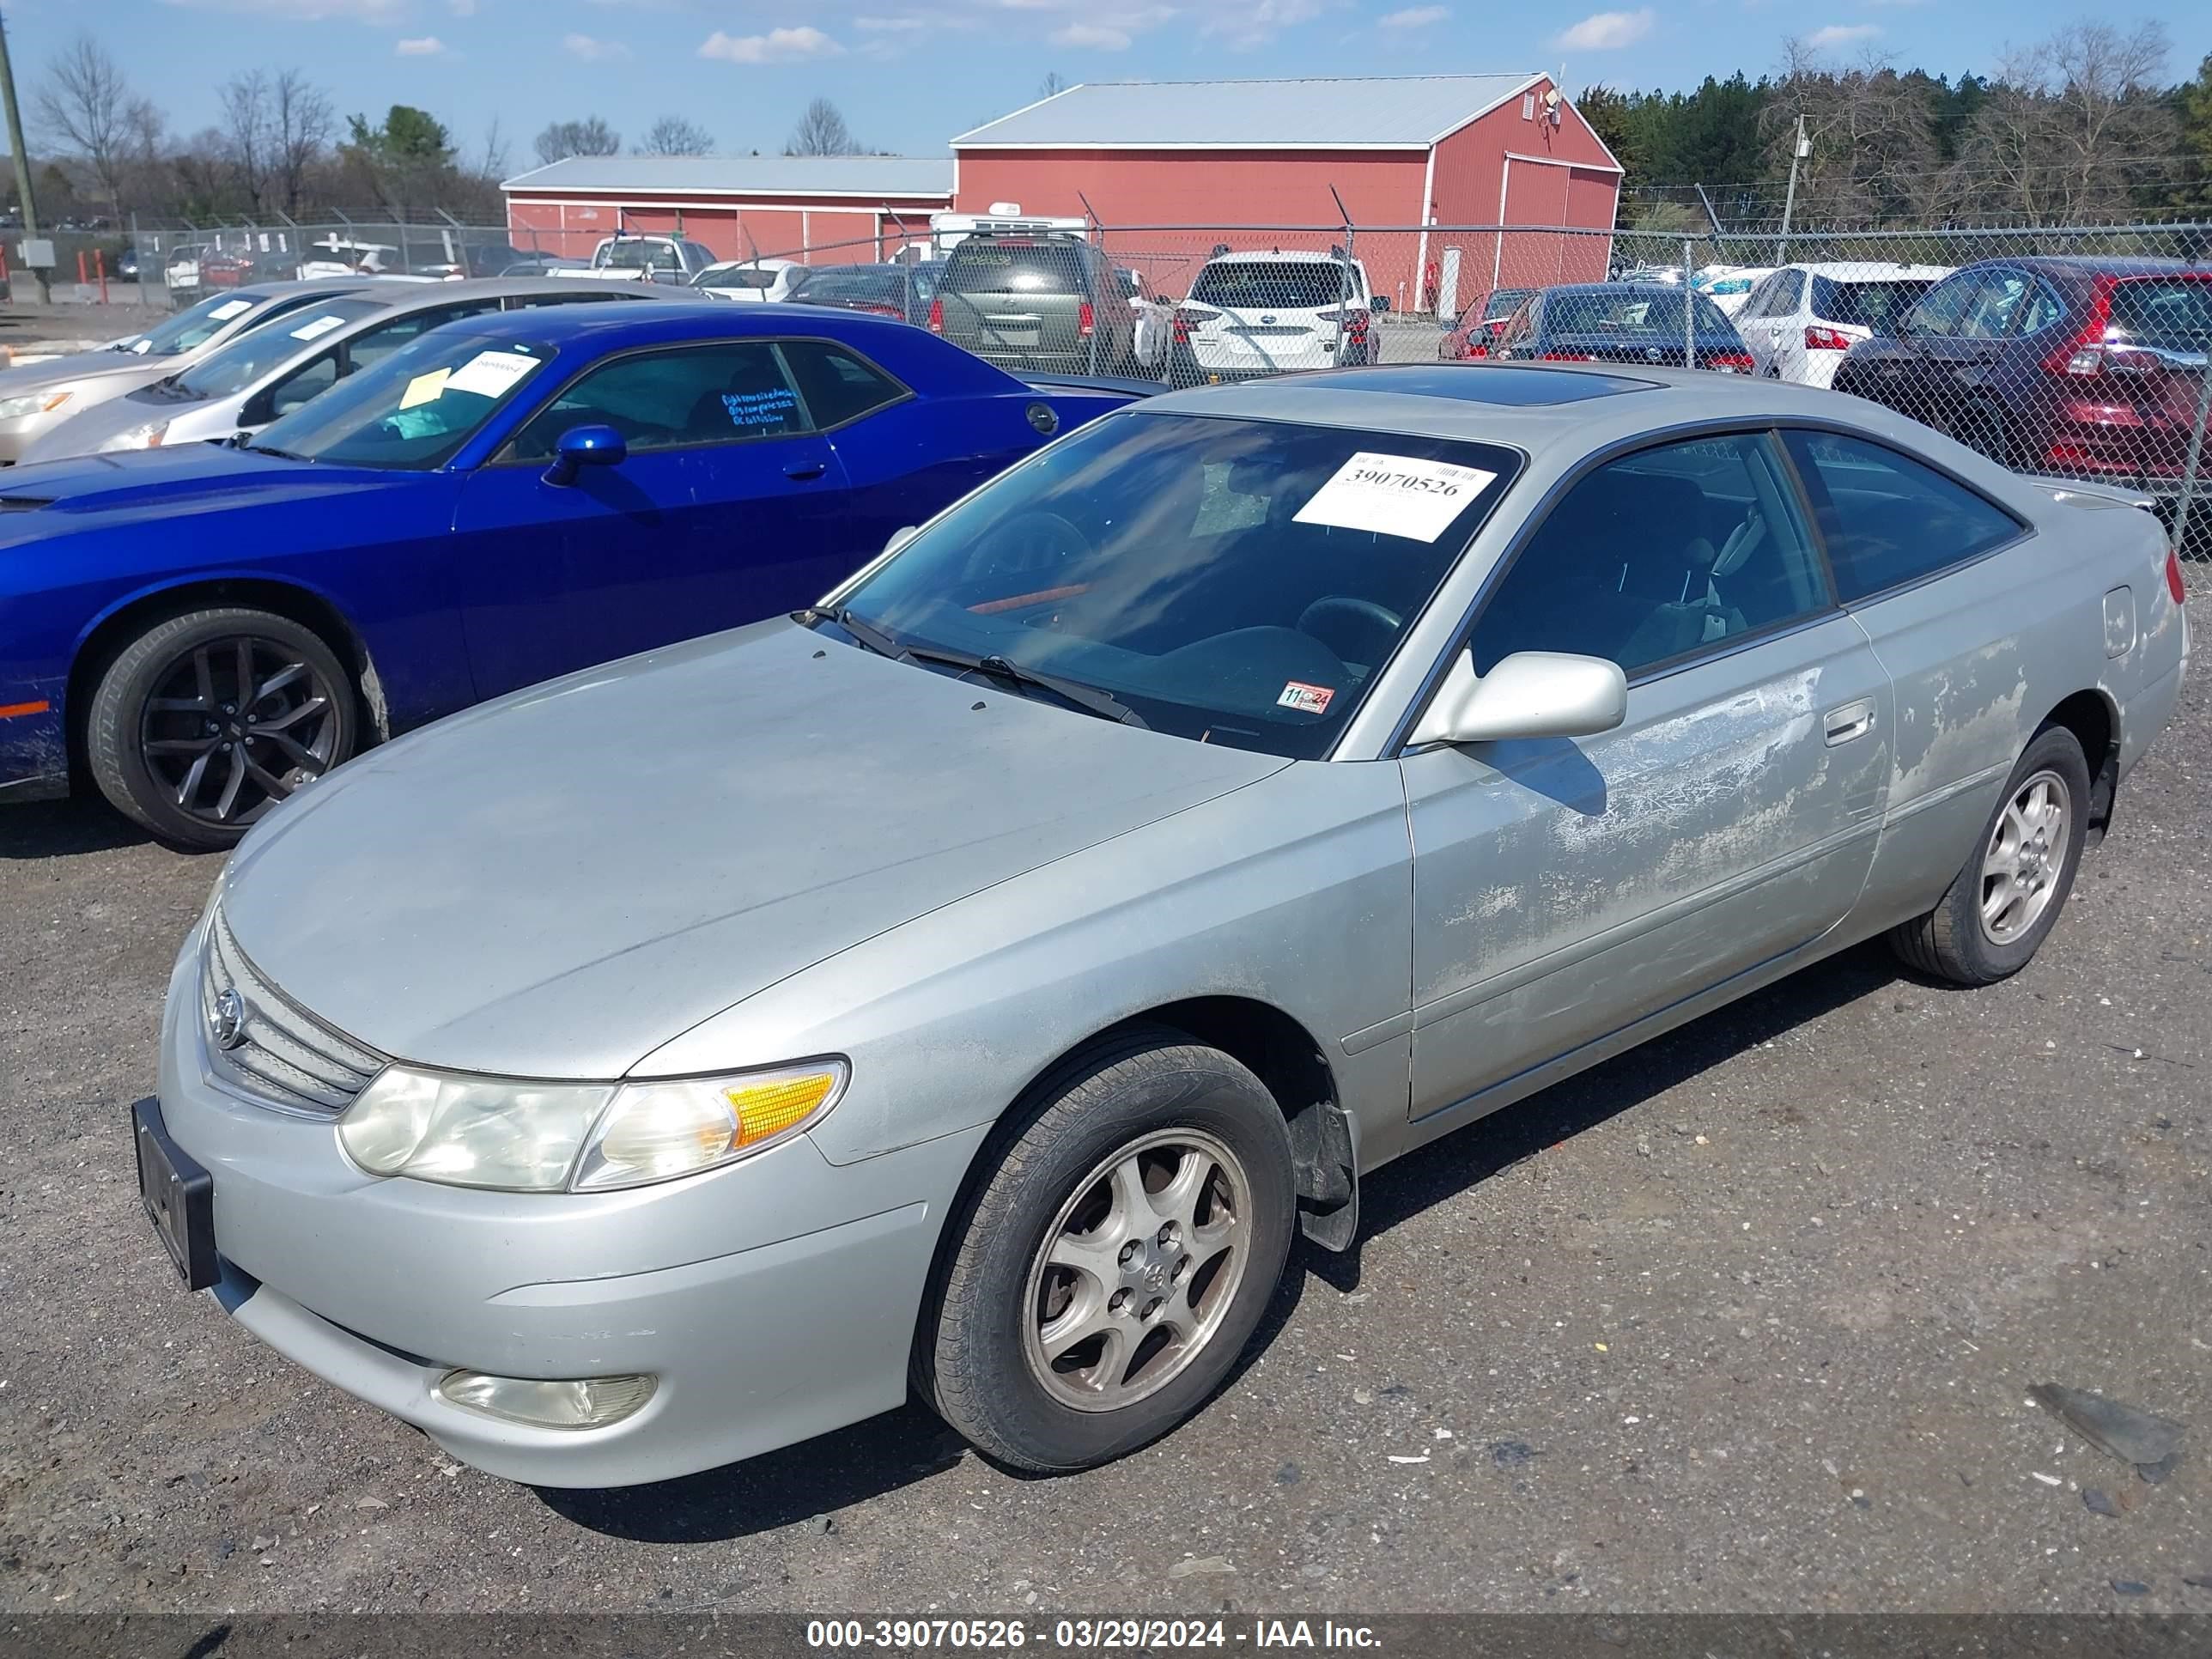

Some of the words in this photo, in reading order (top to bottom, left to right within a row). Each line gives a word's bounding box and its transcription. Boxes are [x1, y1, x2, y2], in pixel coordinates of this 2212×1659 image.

[1346, 469, 1464, 496] 39070526
[1285, 688, 1302, 703] 11
[1313, 693, 1329, 705] 24
